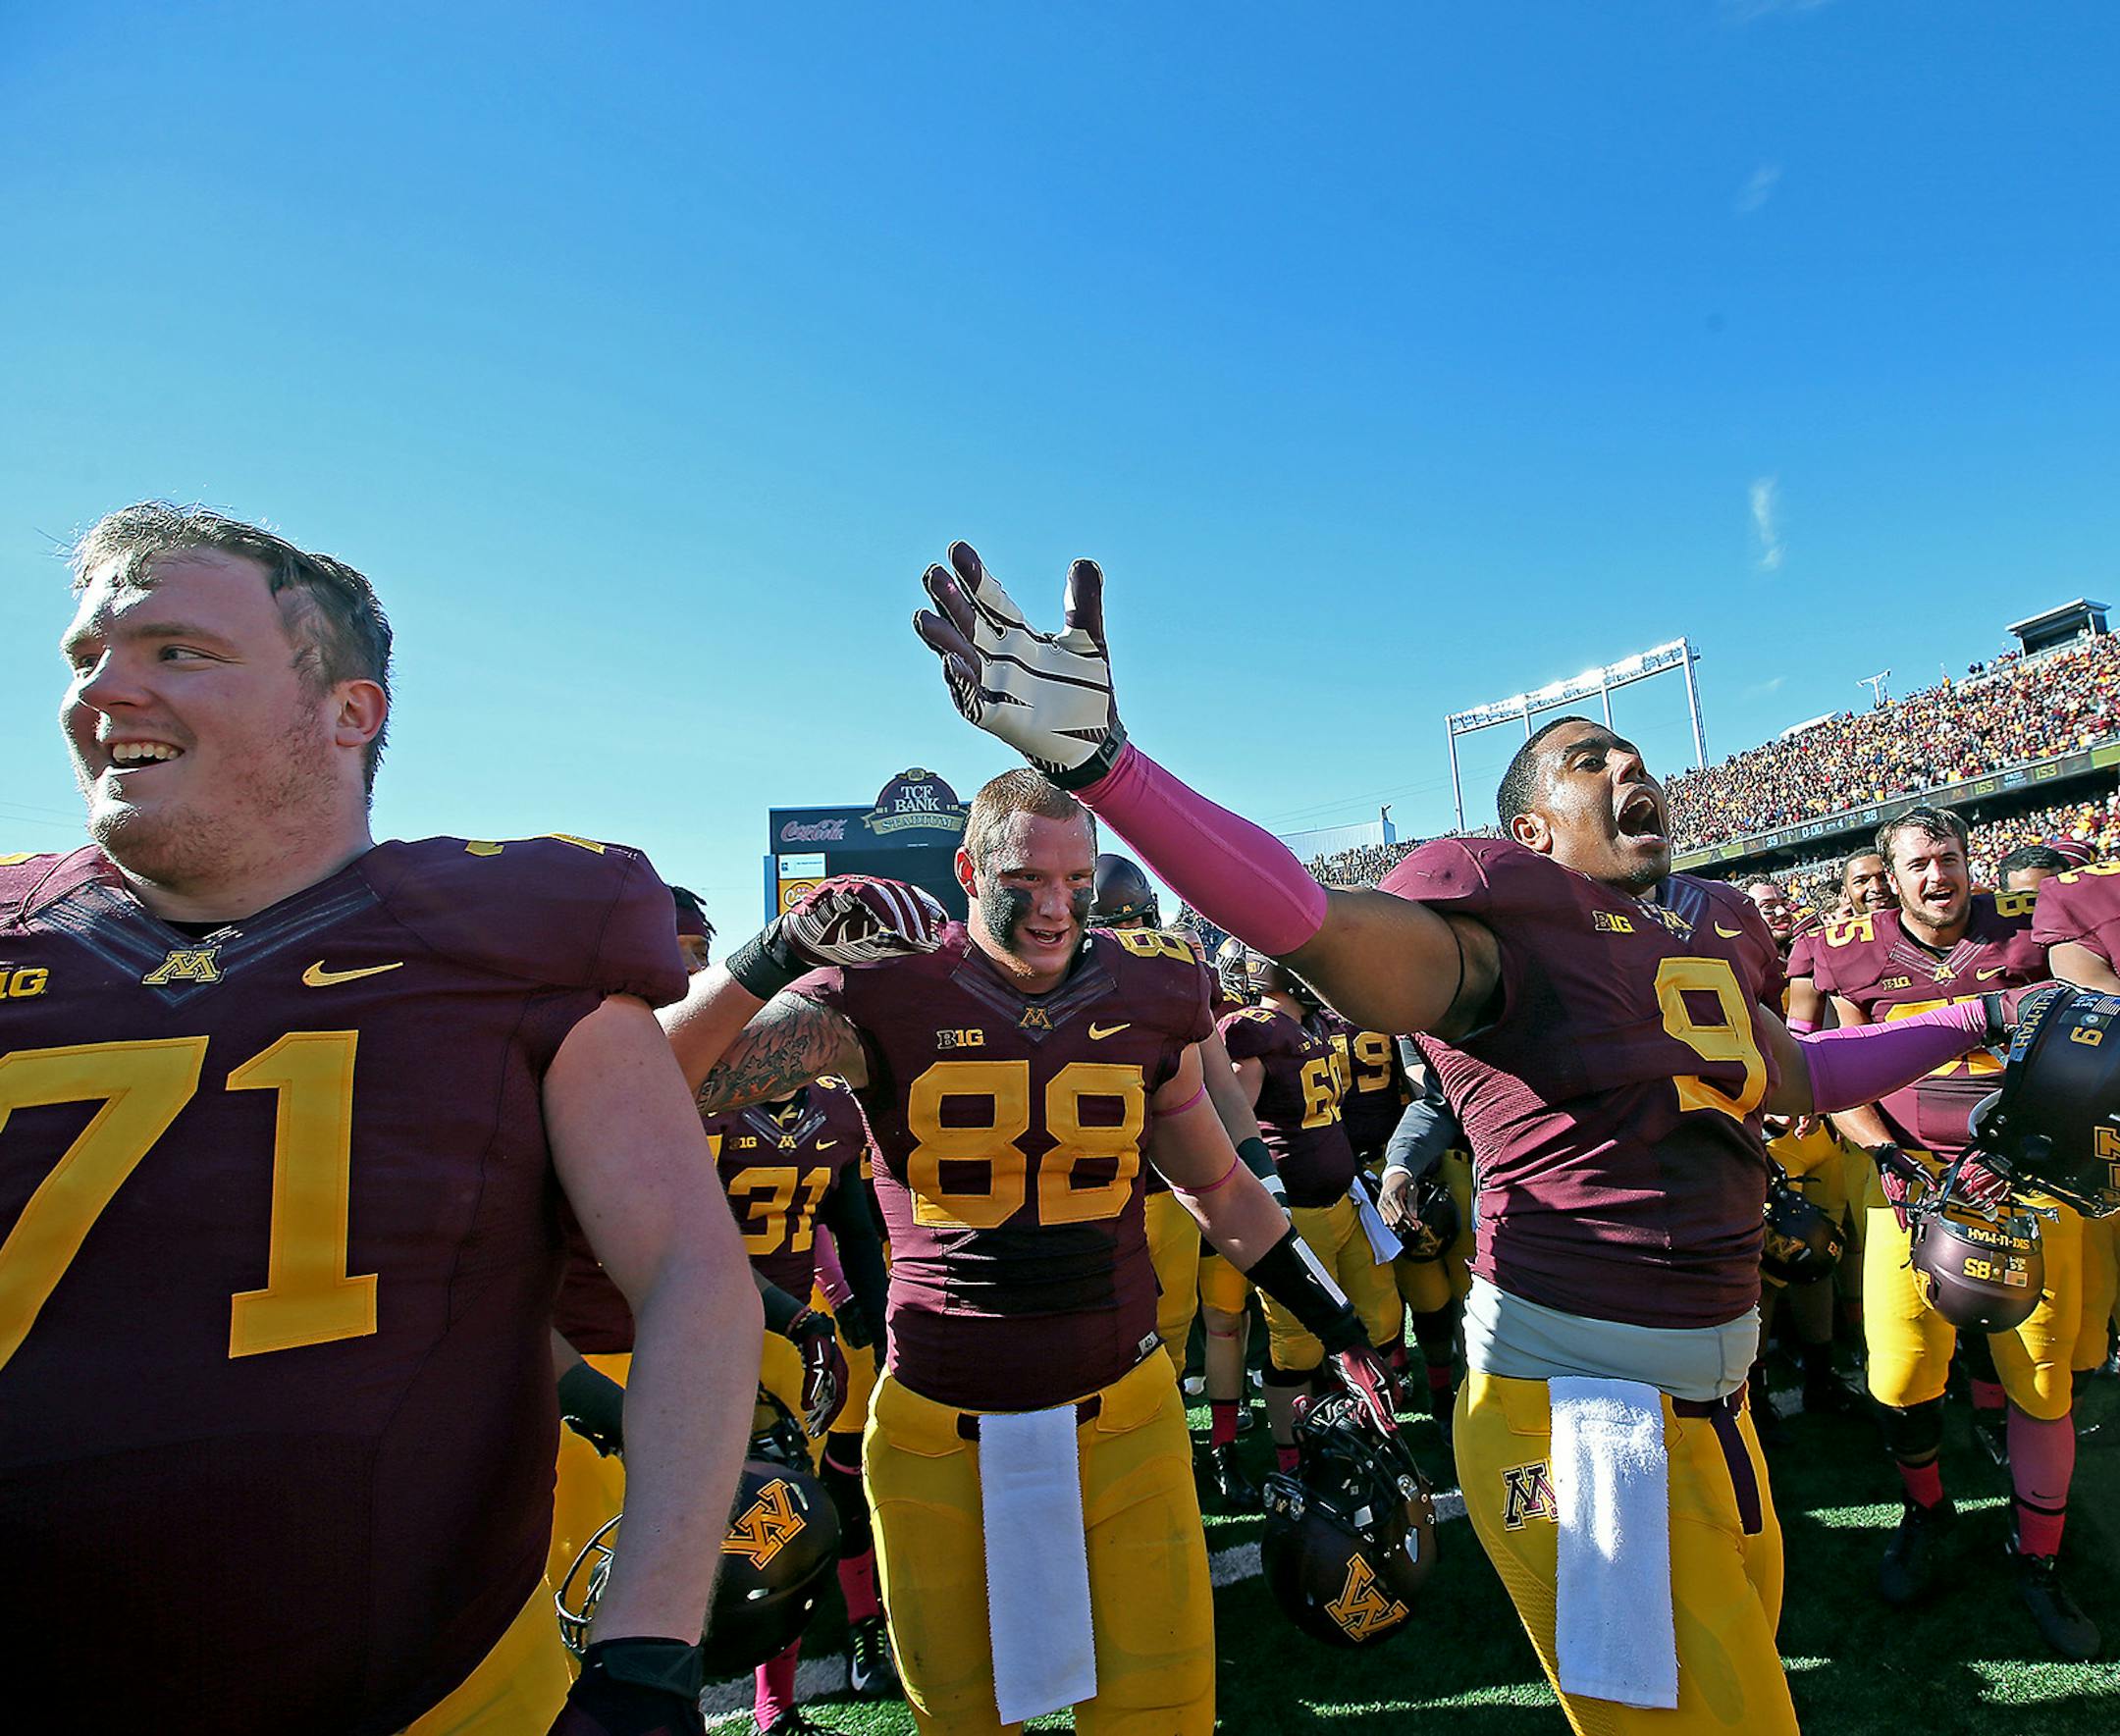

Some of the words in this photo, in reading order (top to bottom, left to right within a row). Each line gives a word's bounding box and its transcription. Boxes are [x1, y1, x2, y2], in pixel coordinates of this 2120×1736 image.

[900, 785, 934, 800] TCF
[894, 798, 940, 814] BANK
[881, 815, 954, 830] STADIUM
[1861, 810, 1879, 823] 38
[1801, 823, 1824, 838] 0:00
[1766, 835, 1778, 848] 39
[1654, 957, 1767, 1124] 9
[907, 1060, 1147, 1230] 88
[0, 1029, 378, 1371] 71
[728, 1167, 831, 1255] 31
